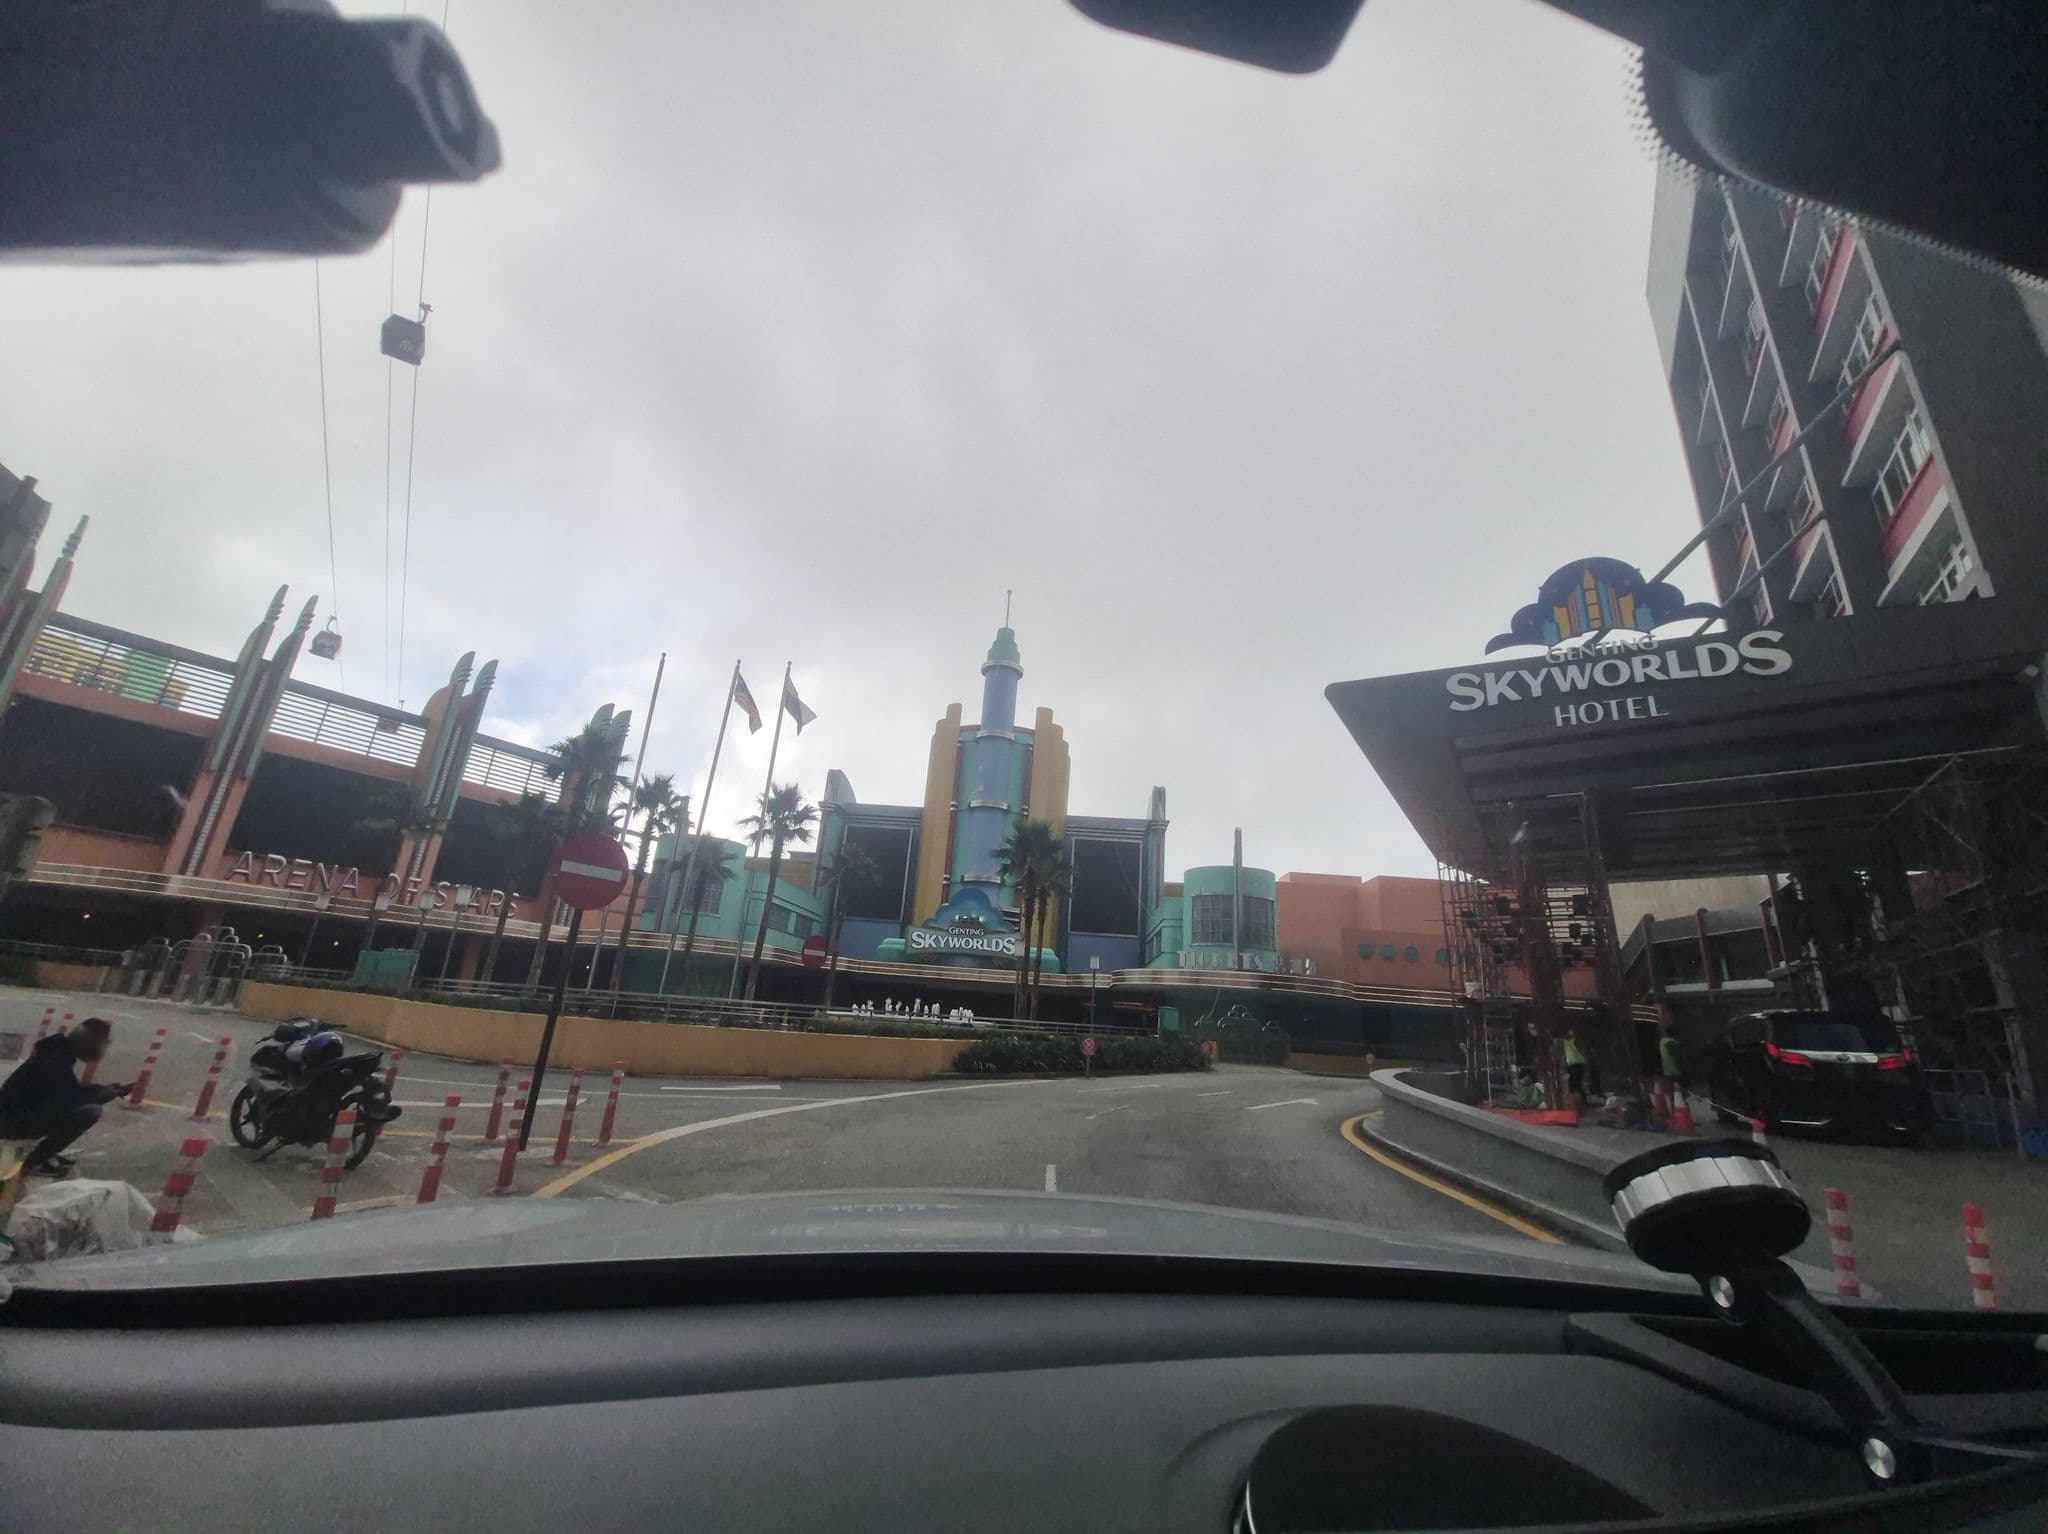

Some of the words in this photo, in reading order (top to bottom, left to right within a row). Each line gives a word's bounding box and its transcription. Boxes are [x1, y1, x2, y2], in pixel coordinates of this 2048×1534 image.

[1546, 634, 1659, 664] GENTING
[1446, 630, 1793, 712] SKYWORLDS
[1554, 695, 1671, 727] HOTEL
[225, 850, 360, 898] ARENA
[911, 931, 1017, 955] SKYWORLDS
[948, 926, 985, 936] GENTING
